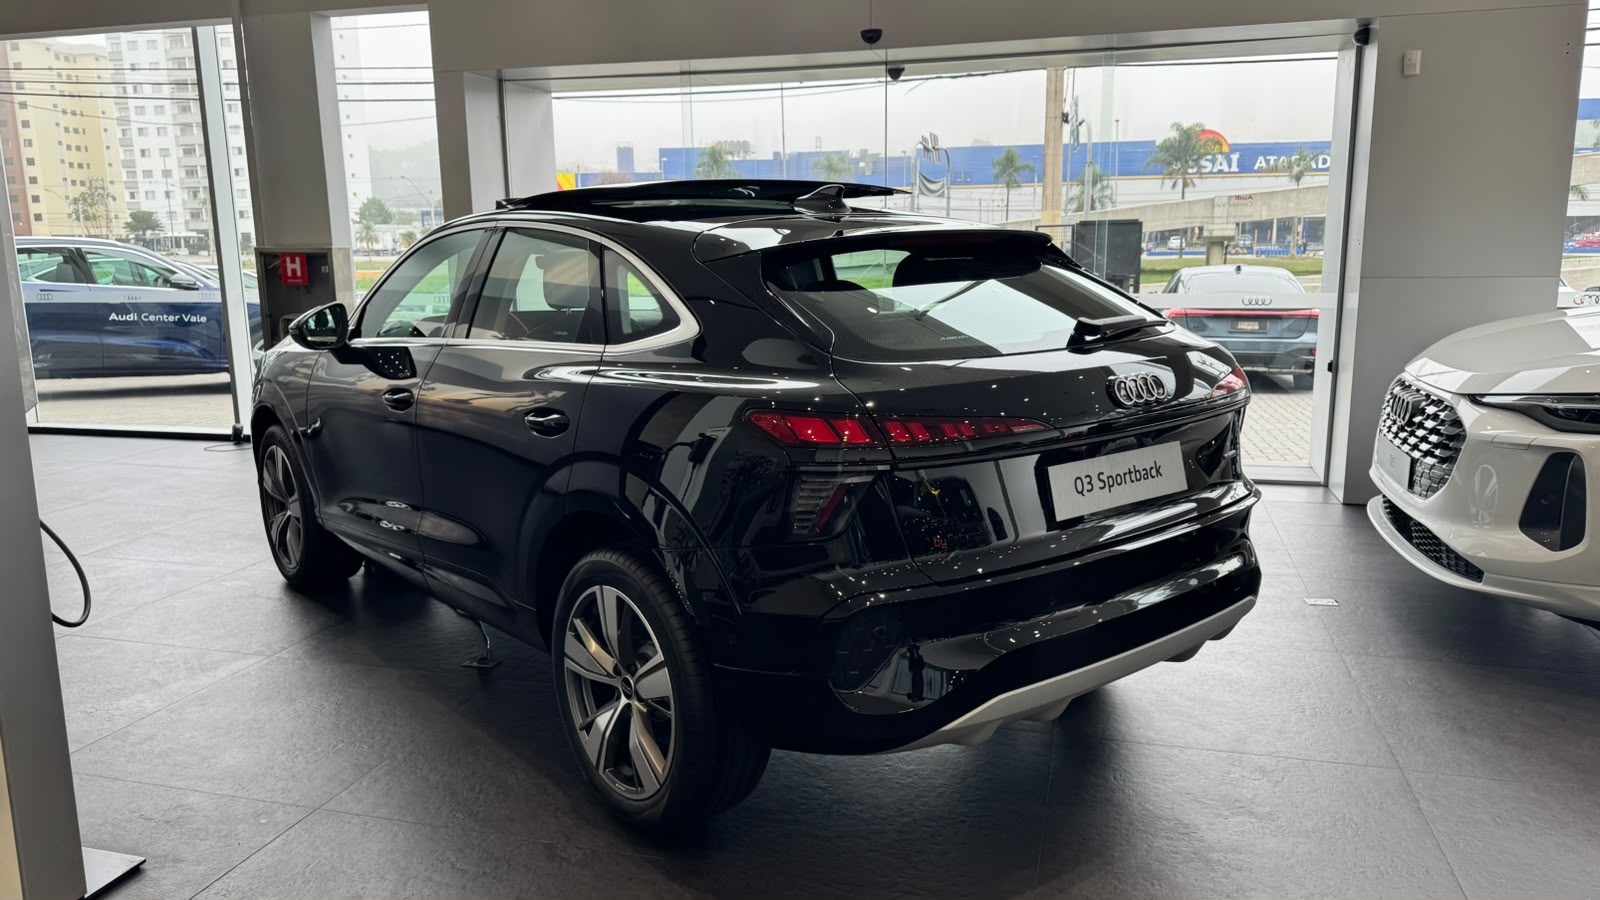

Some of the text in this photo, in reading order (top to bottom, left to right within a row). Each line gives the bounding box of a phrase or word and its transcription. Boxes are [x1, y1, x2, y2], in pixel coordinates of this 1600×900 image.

[286, 256, 302, 277] H
[108, 312, 207, 323] Audi Center Vale
[1074, 460, 1164, 497] Q3 Sportback
